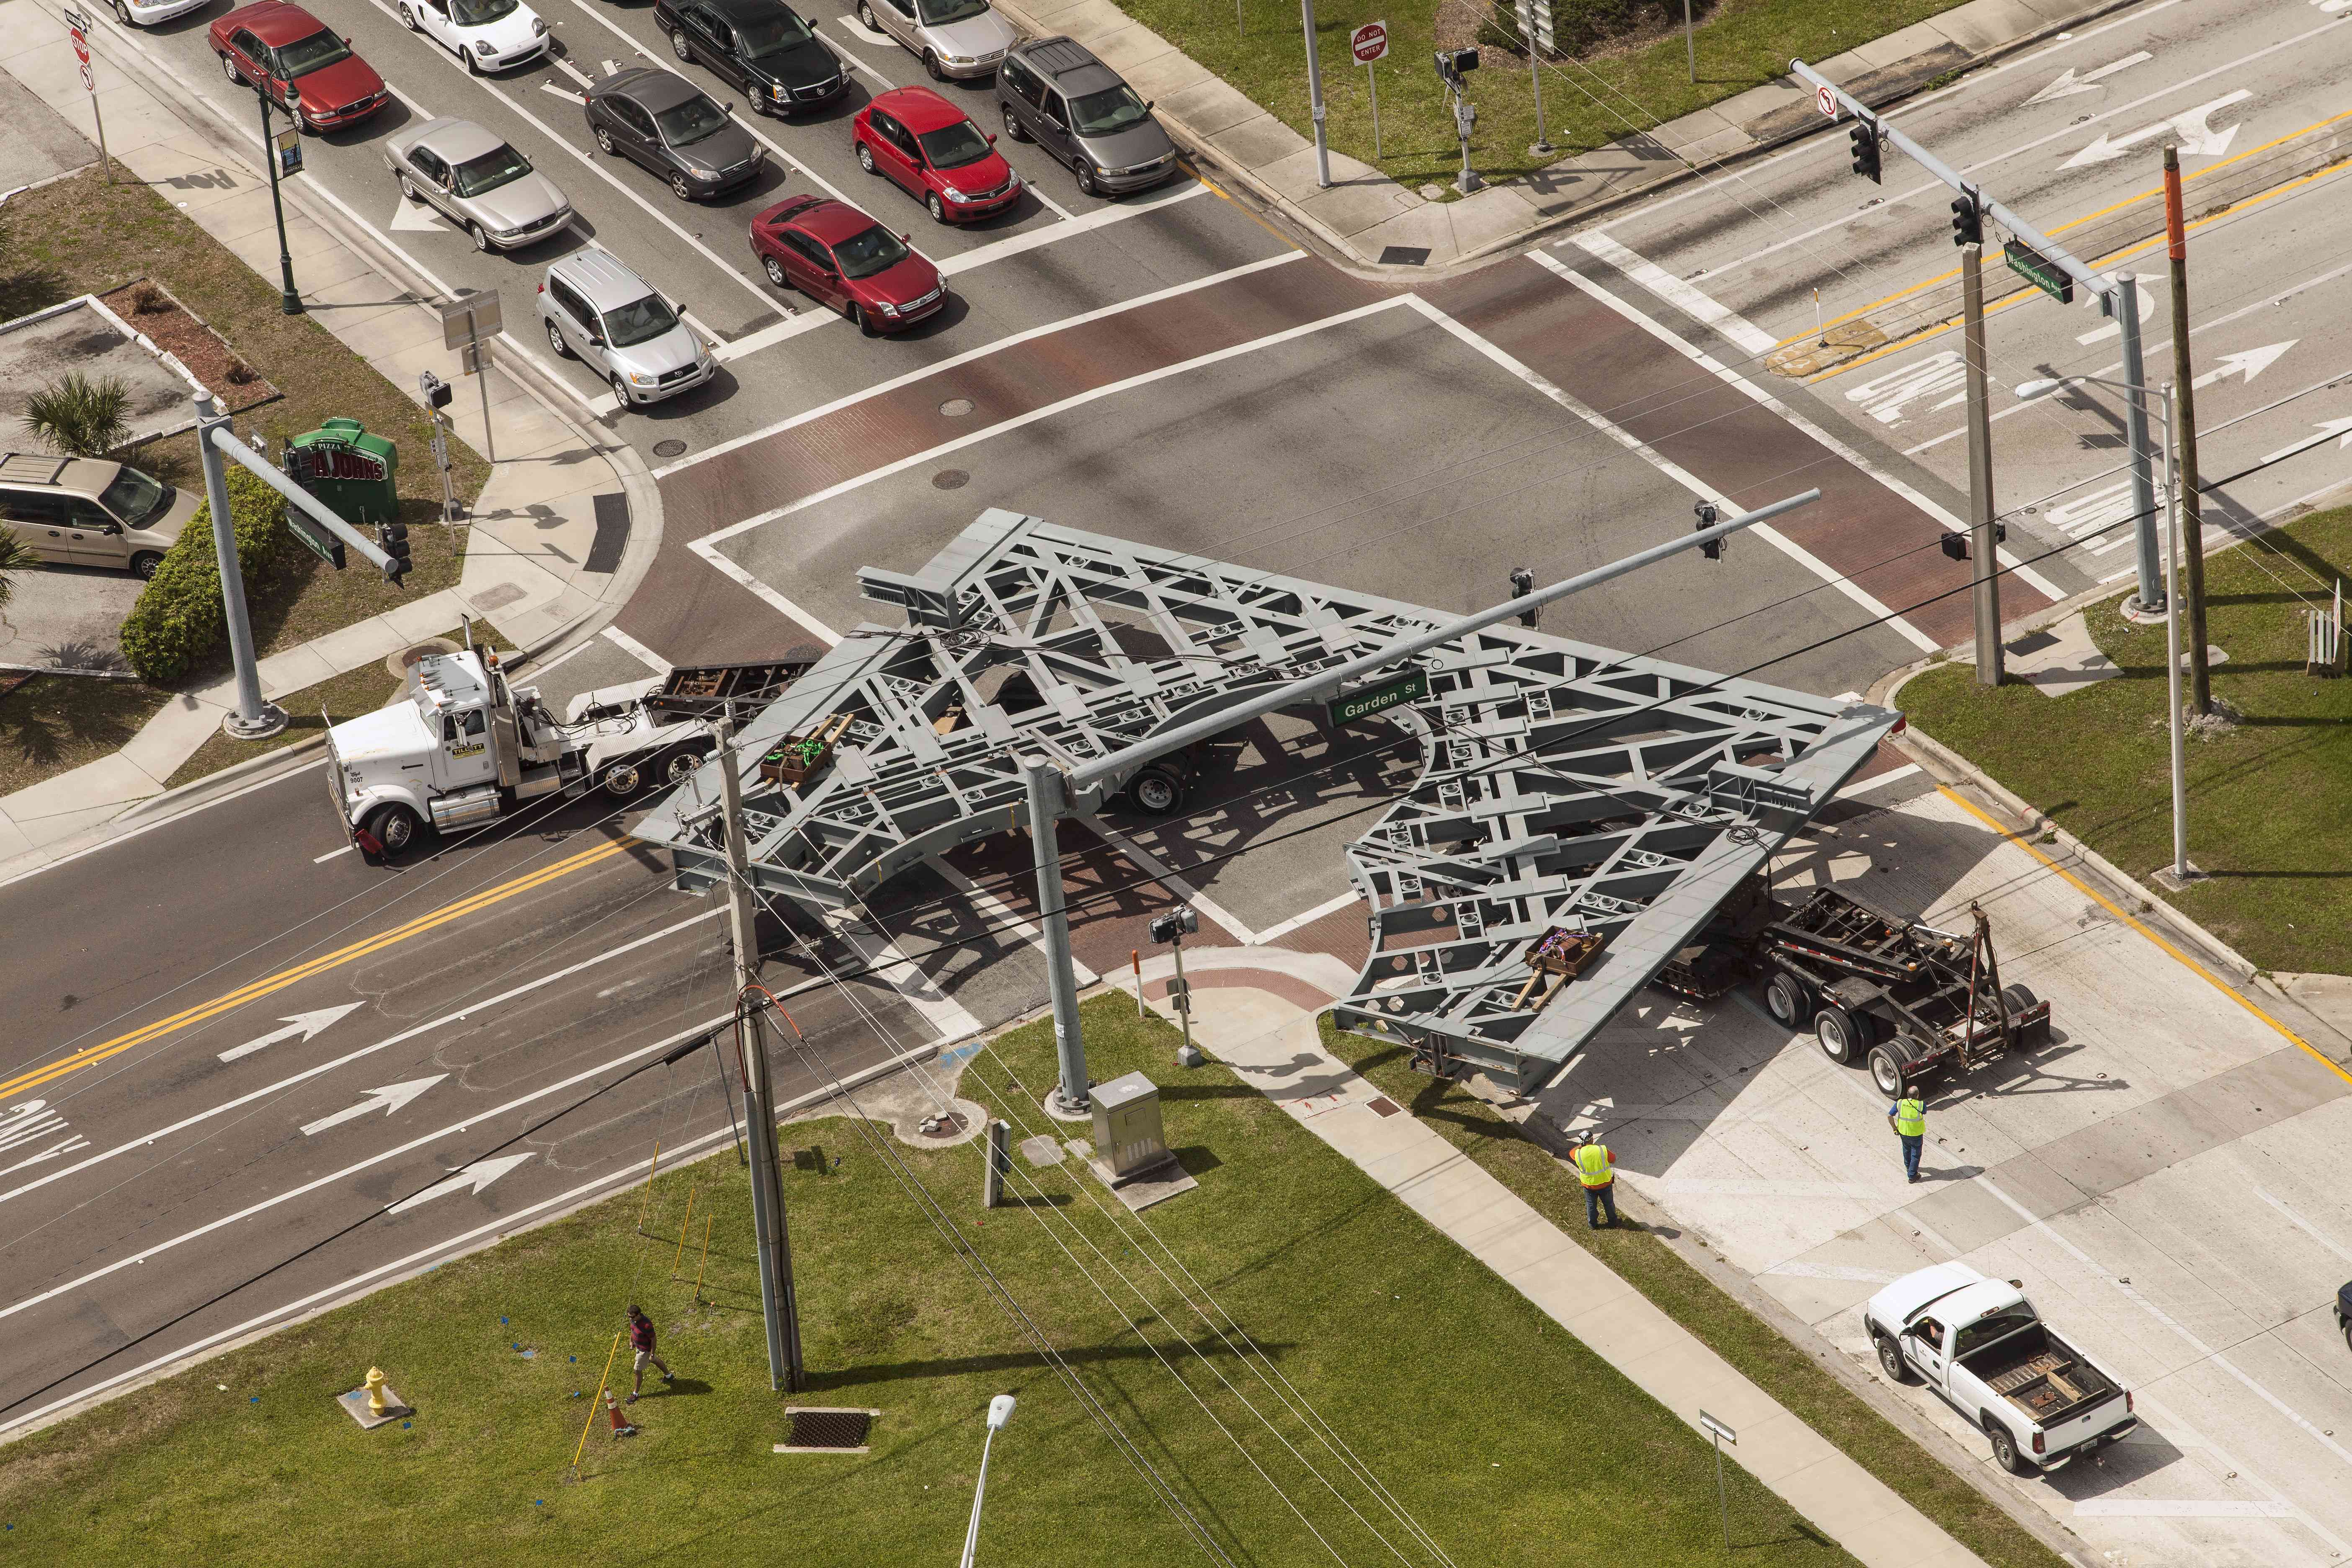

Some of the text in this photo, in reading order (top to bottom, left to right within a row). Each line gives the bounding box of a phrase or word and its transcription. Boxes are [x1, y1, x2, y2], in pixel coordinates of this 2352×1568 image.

[1369, 28, 1380, 38] NOT
[72, 34, 88, 55] STOP
[1361, 45, 1380, 57] ENTER
[2006, 250, 2061, 293] Washington Ave
[286, 516, 334, 562] Washington Ave
[1345, 683, 1416, 717] Garden St
[453, 744, 482, 754] TILLTT
